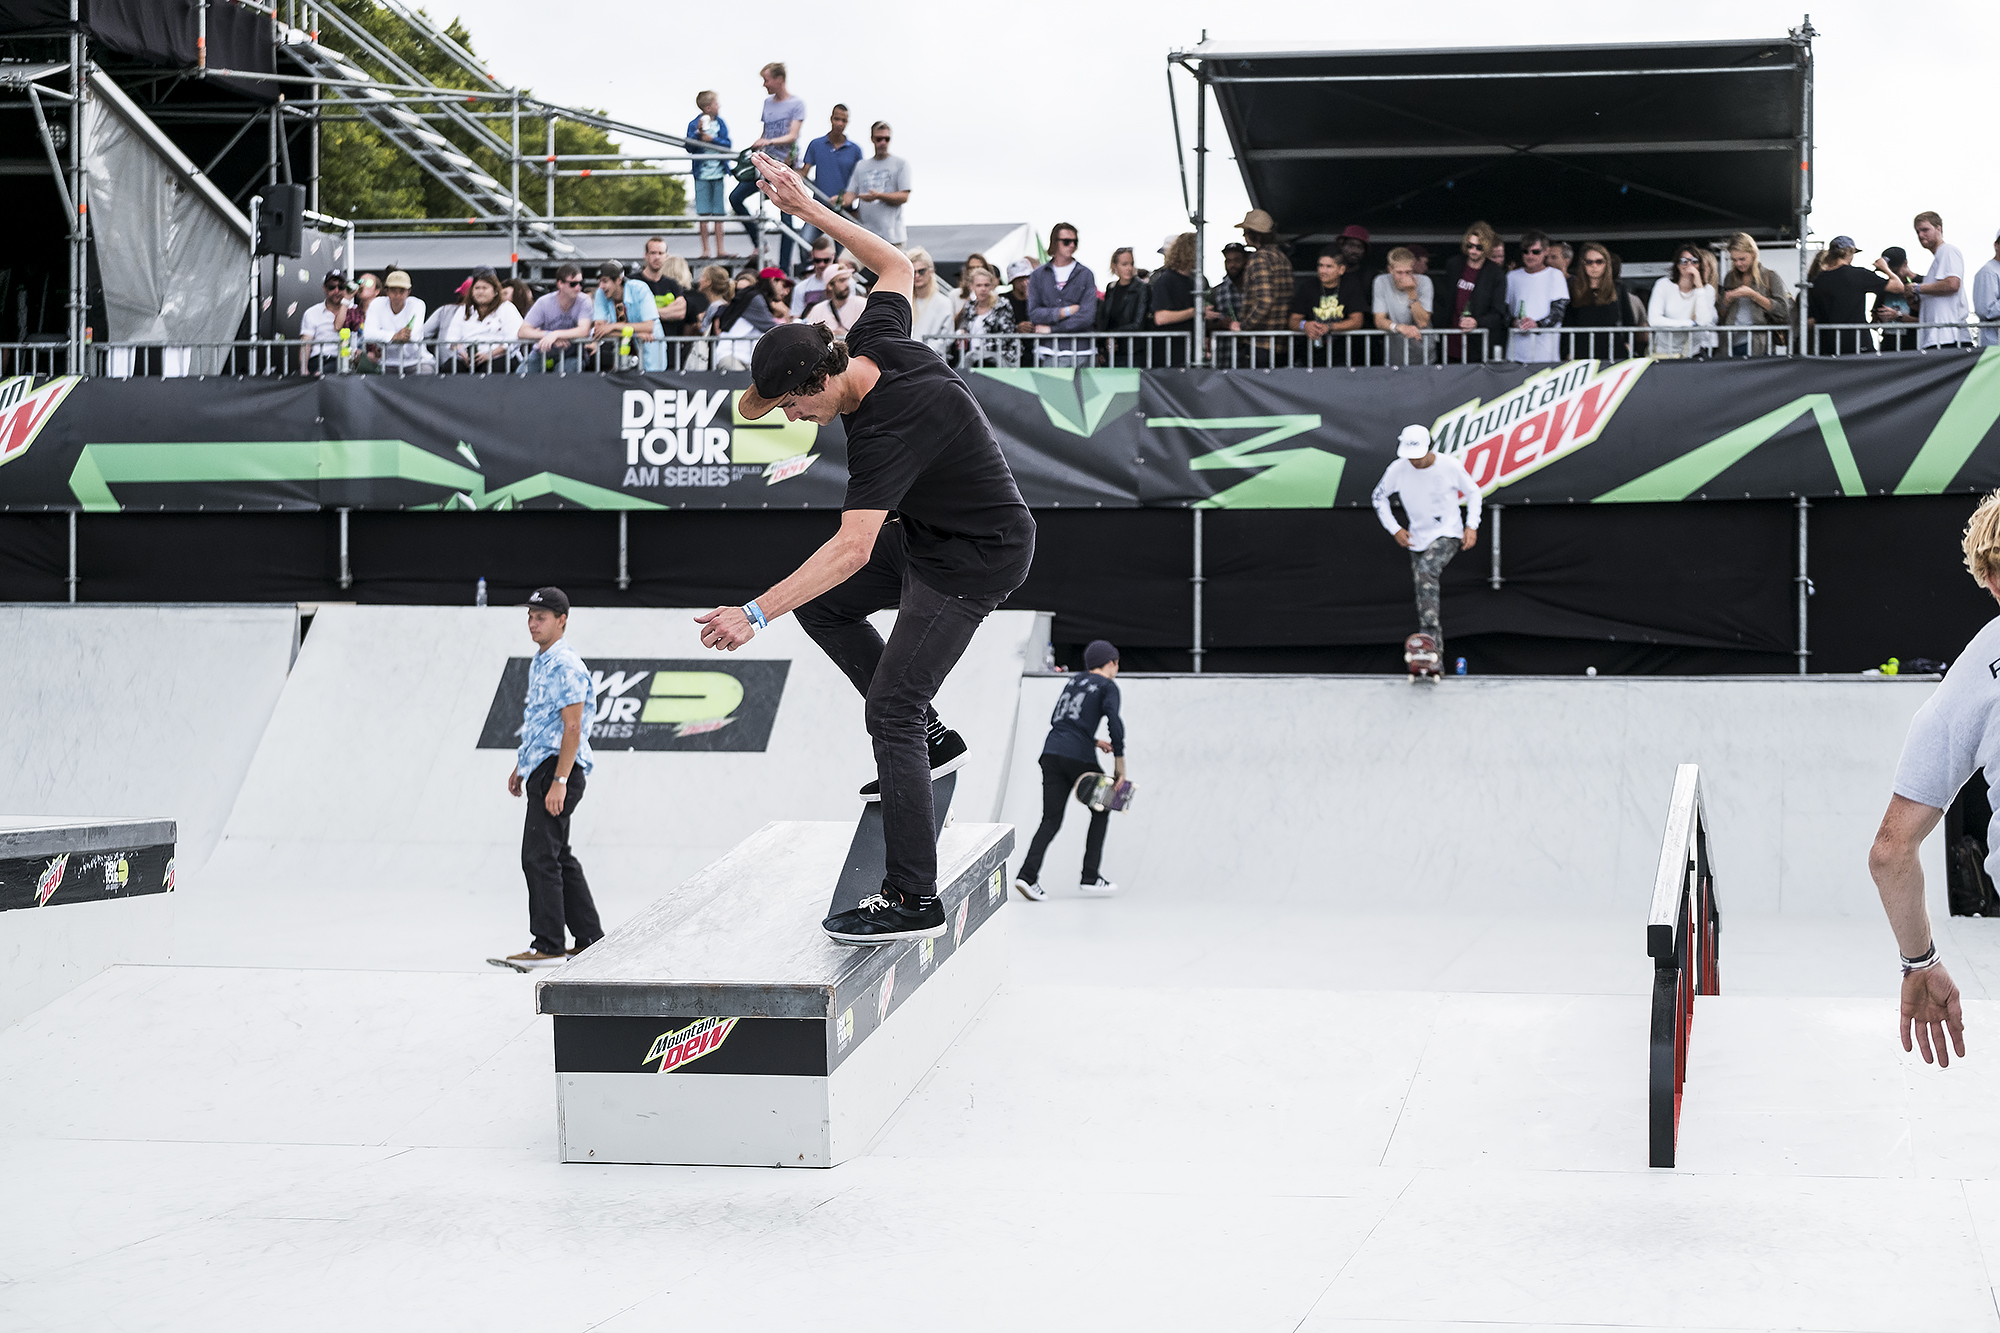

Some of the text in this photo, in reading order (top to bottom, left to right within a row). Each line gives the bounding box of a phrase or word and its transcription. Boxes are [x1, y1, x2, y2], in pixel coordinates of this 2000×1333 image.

[622, 389, 730, 428] DEW
[1429, 362, 1590, 454] Mountain
[621, 427, 730, 466] TOUR
[623, 466, 731, 487] AM SERIES
[649, 1017, 717, 1058] Mountain
